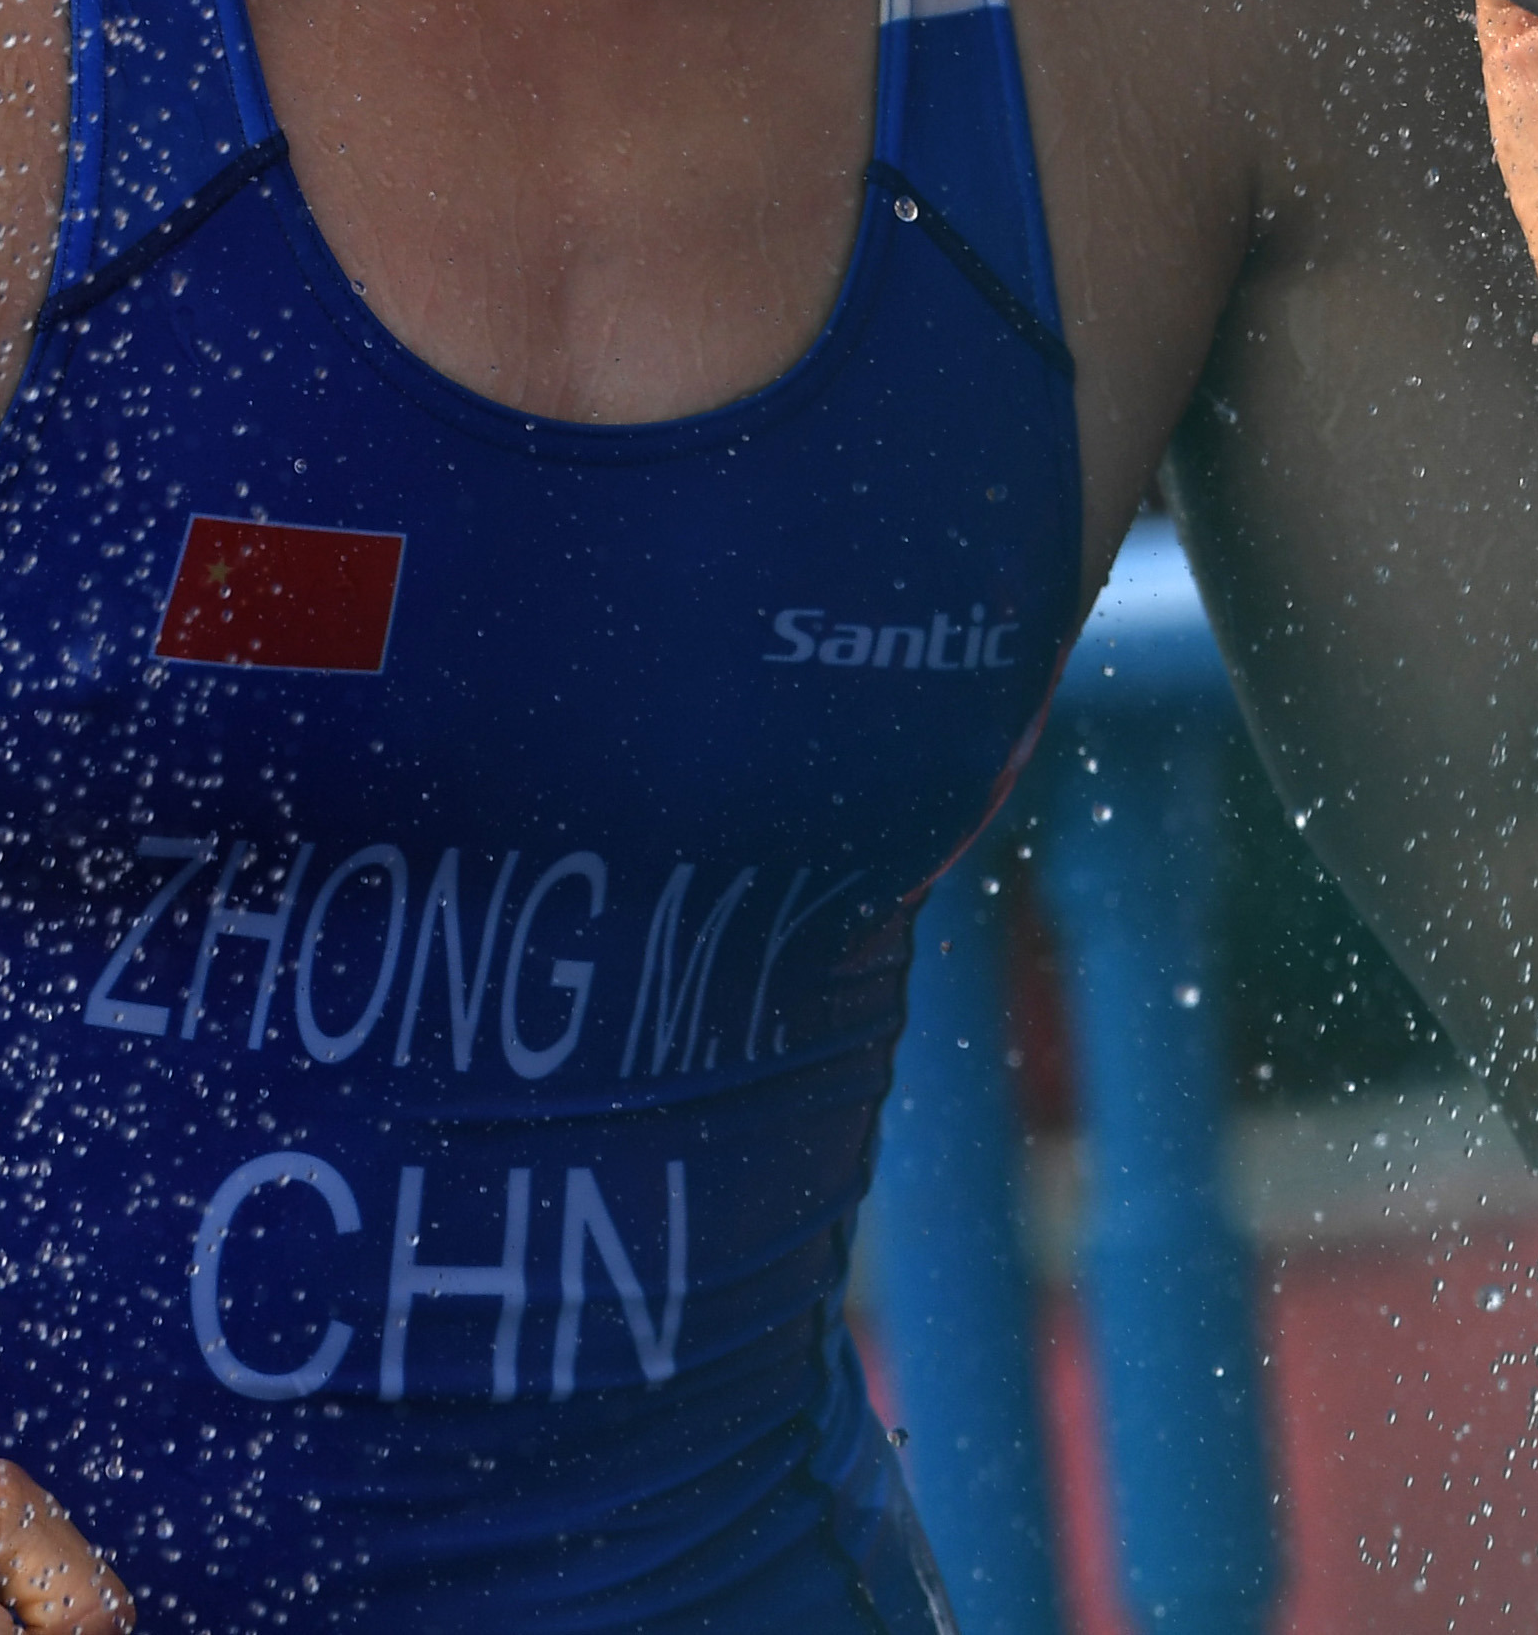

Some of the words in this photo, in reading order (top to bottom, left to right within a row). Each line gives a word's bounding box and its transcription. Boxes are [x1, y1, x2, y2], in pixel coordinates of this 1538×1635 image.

[762, 602, 1020, 671] Santic
[83, 836, 608, 1080] ZHONG
[189, 1151, 688, 1402] CHN
